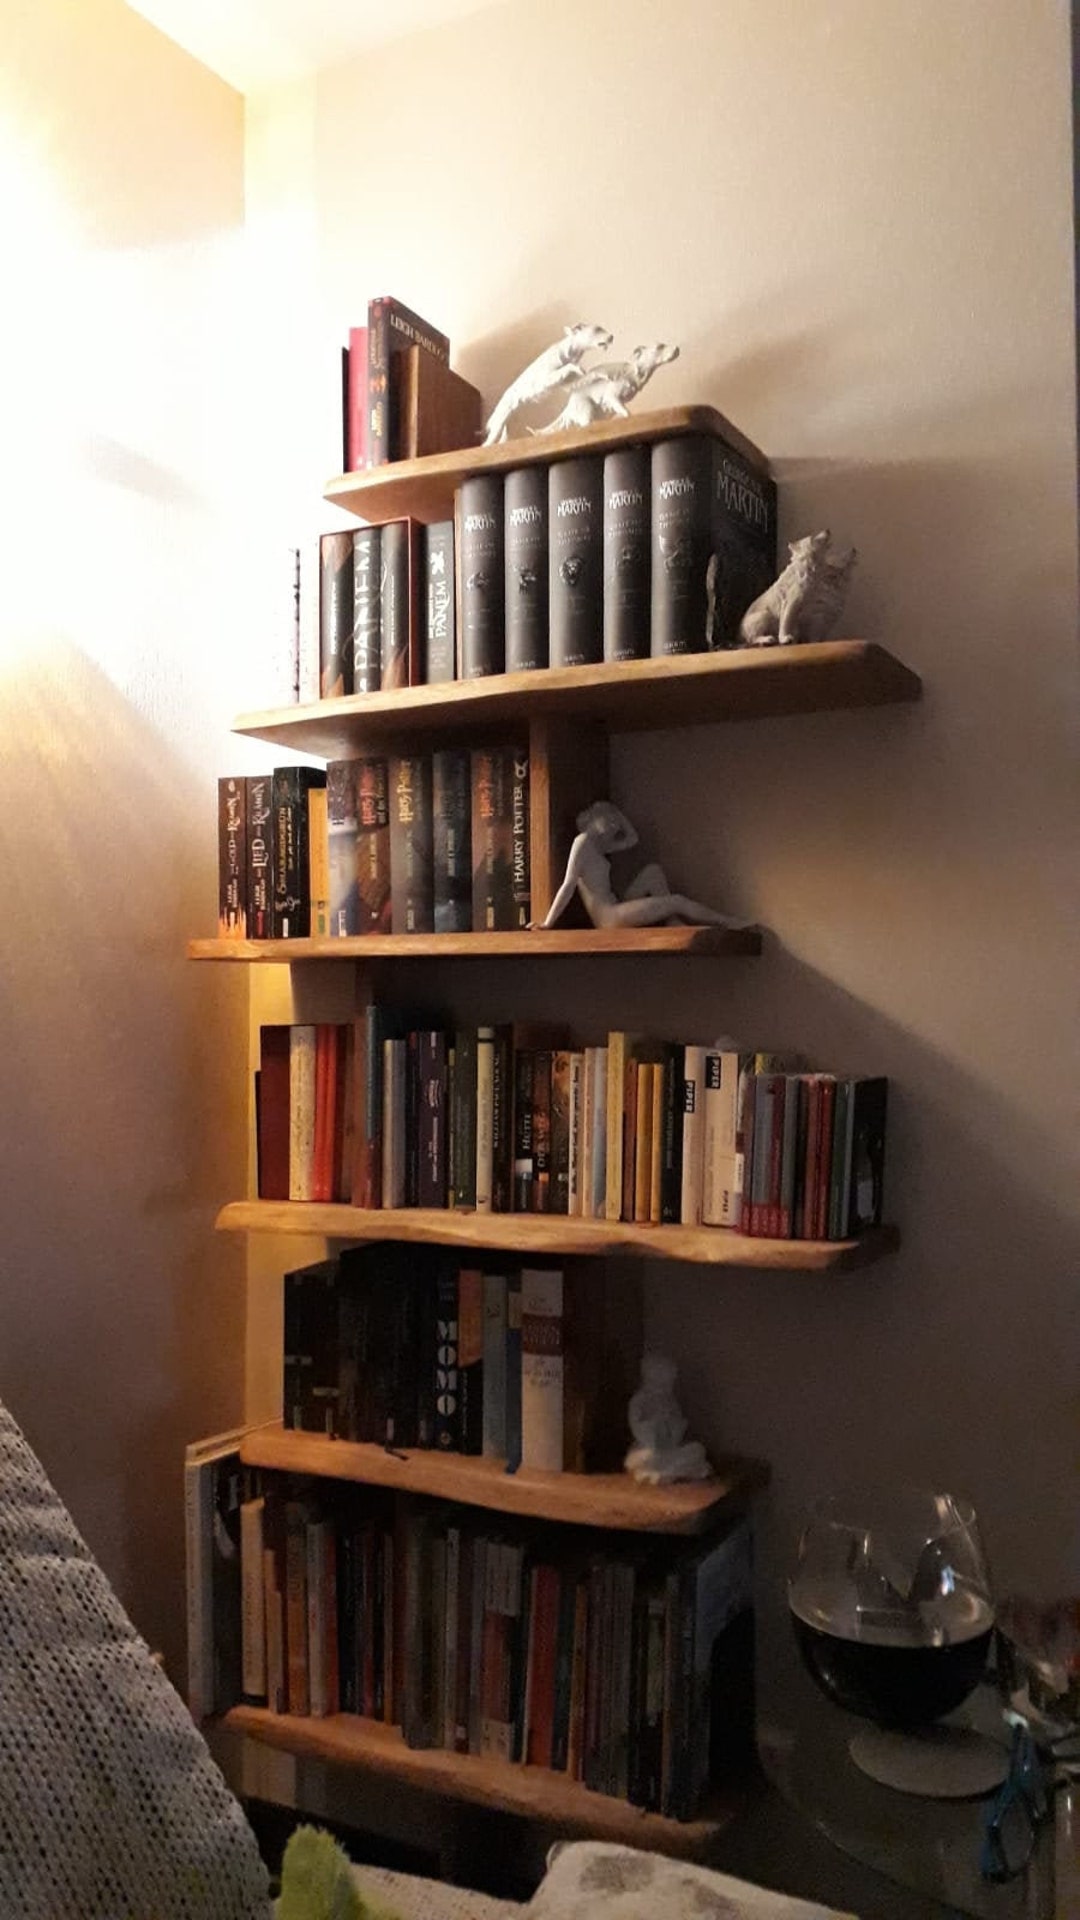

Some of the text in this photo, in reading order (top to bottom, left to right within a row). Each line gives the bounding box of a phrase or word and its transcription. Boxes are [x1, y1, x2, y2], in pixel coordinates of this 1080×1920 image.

[717, 470, 768, 533] MARTIN
[435, 580, 450, 637] PANEM
[251, 839, 269, 867] LIED
[513, 785, 525, 882] HARRY POTTER
[711, 1057, 720, 1088] PIPER
[686, 1081, 695, 1112] PIPER
